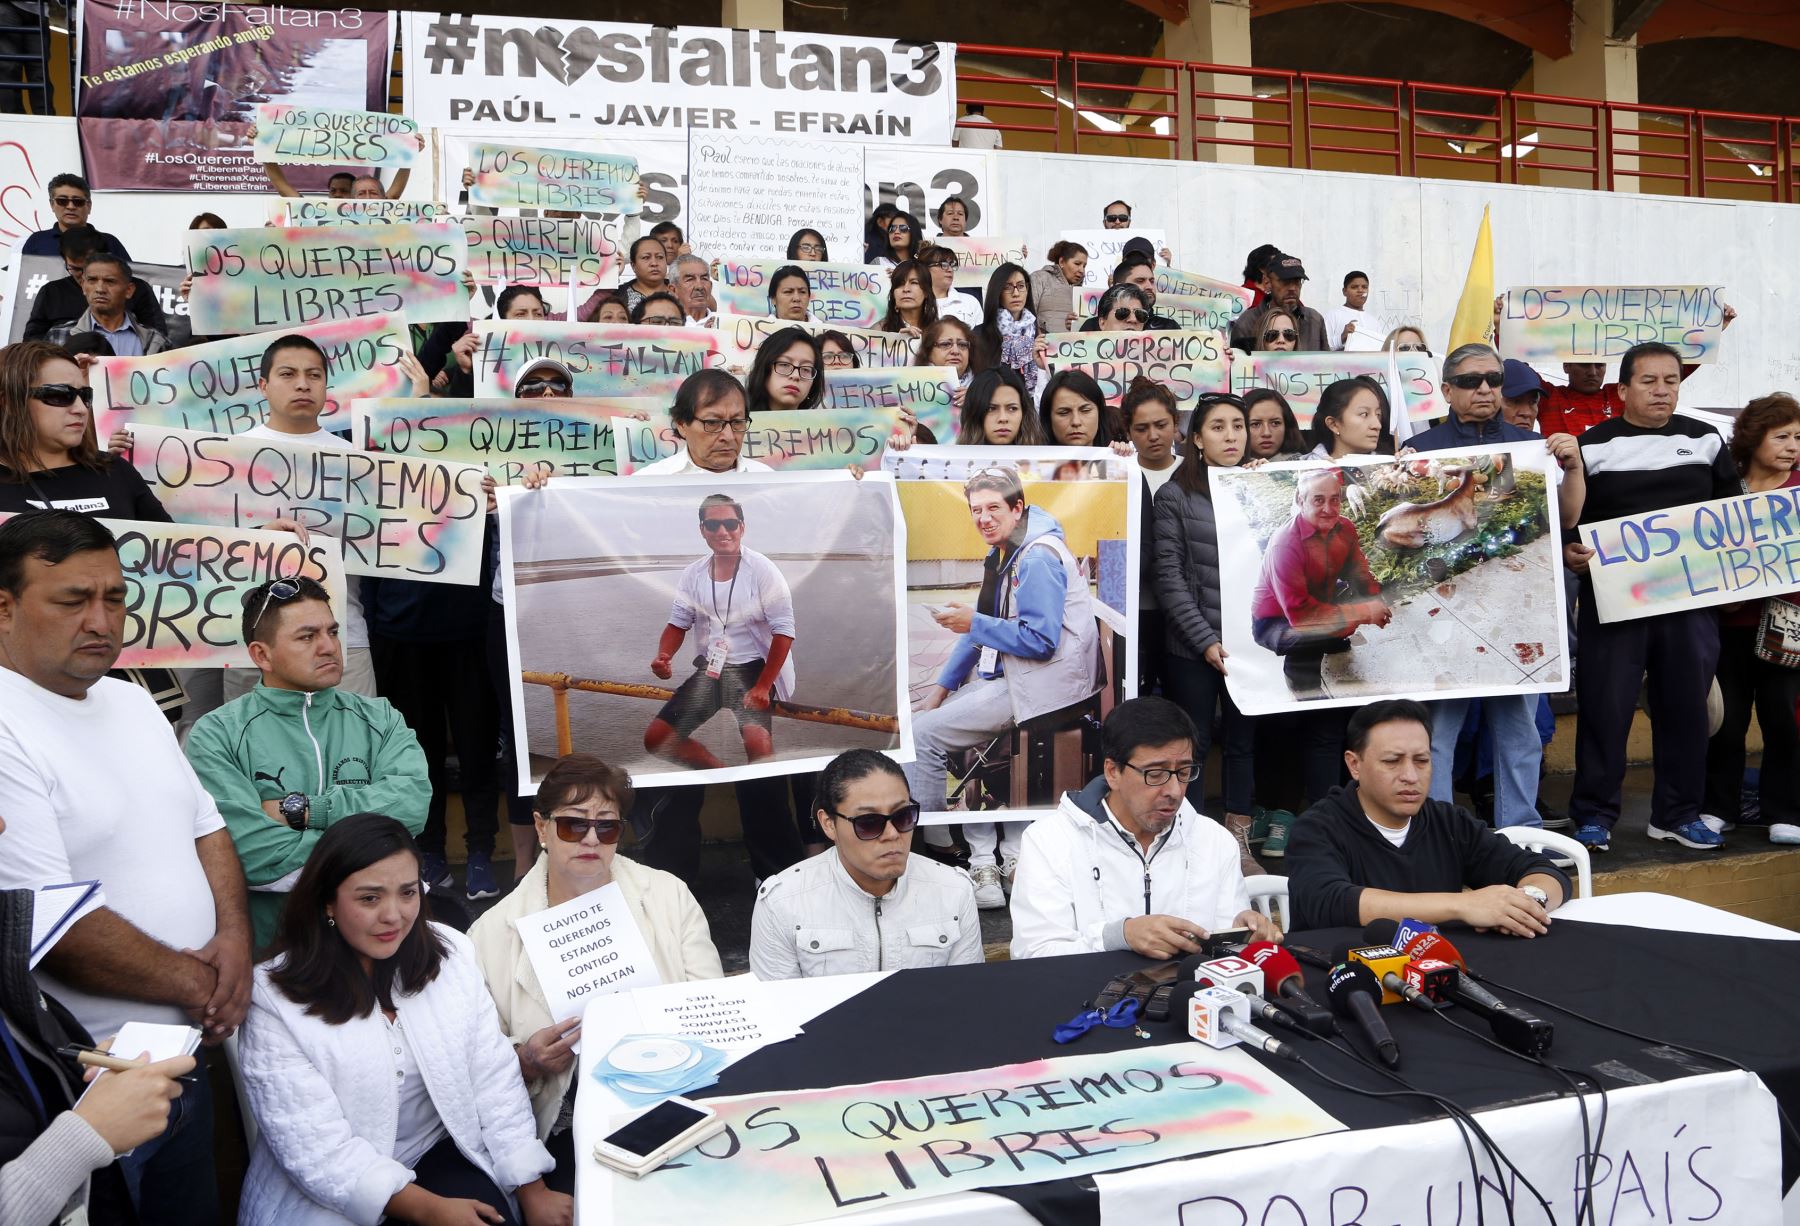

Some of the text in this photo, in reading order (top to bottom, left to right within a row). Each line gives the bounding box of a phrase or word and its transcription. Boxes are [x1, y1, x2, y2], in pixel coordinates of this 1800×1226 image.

[81, 24, 275, 89] Te estamos esperando amigo
[273, 109, 413, 134] LOS QUEREMOS
[449, 95, 557, 124] PAÚL
[592, 103, 738, 131] JAVIER
[773, 109, 912, 138] EFRAÍN
[275, 128, 388, 161] LIBRES
[480, 149, 640, 184] LOS QUEREMOS
[286, 202, 328, 220] LOS
[517, 181, 617, 206] LIBRES
[492, 218, 618, 258] QUEREMOS
[187, 243, 457, 281] LOS QUEREMOS
[487, 249, 601, 286] LIBRES
[724, 263, 764, 288] LOS
[254, 283, 404, 326] LIBRES
[1505, 286, 1725, 329] LOS QUEREMOS
[1044, 335, 1219, 361] LOS QUEREMOS
[104, 365, 178, 411] LOS
[364, 415, 617, 453] LOS QUEREM
[129, 431, 484, 521] LOS QUEREMOS
[1590, 514, 1681, 567] LOS
[542, 903, 605, 934] CLAVITO TE
[547, 918, 612, 950] QUEREMOS
[560, 935, 614, 964] ESTAMOS
[567, 951, 620, 979] CONTIGO
[566, 964, 636, 1000] NOS FALTAN
[679, 1009, 741, 1020] CONTIGO
[680, 1017, 747, 1028] ESTAMOS
[842, 1061, 1223, 1142] QUEREMOS
[815, 1117, 1161, 1208] LIBRES
